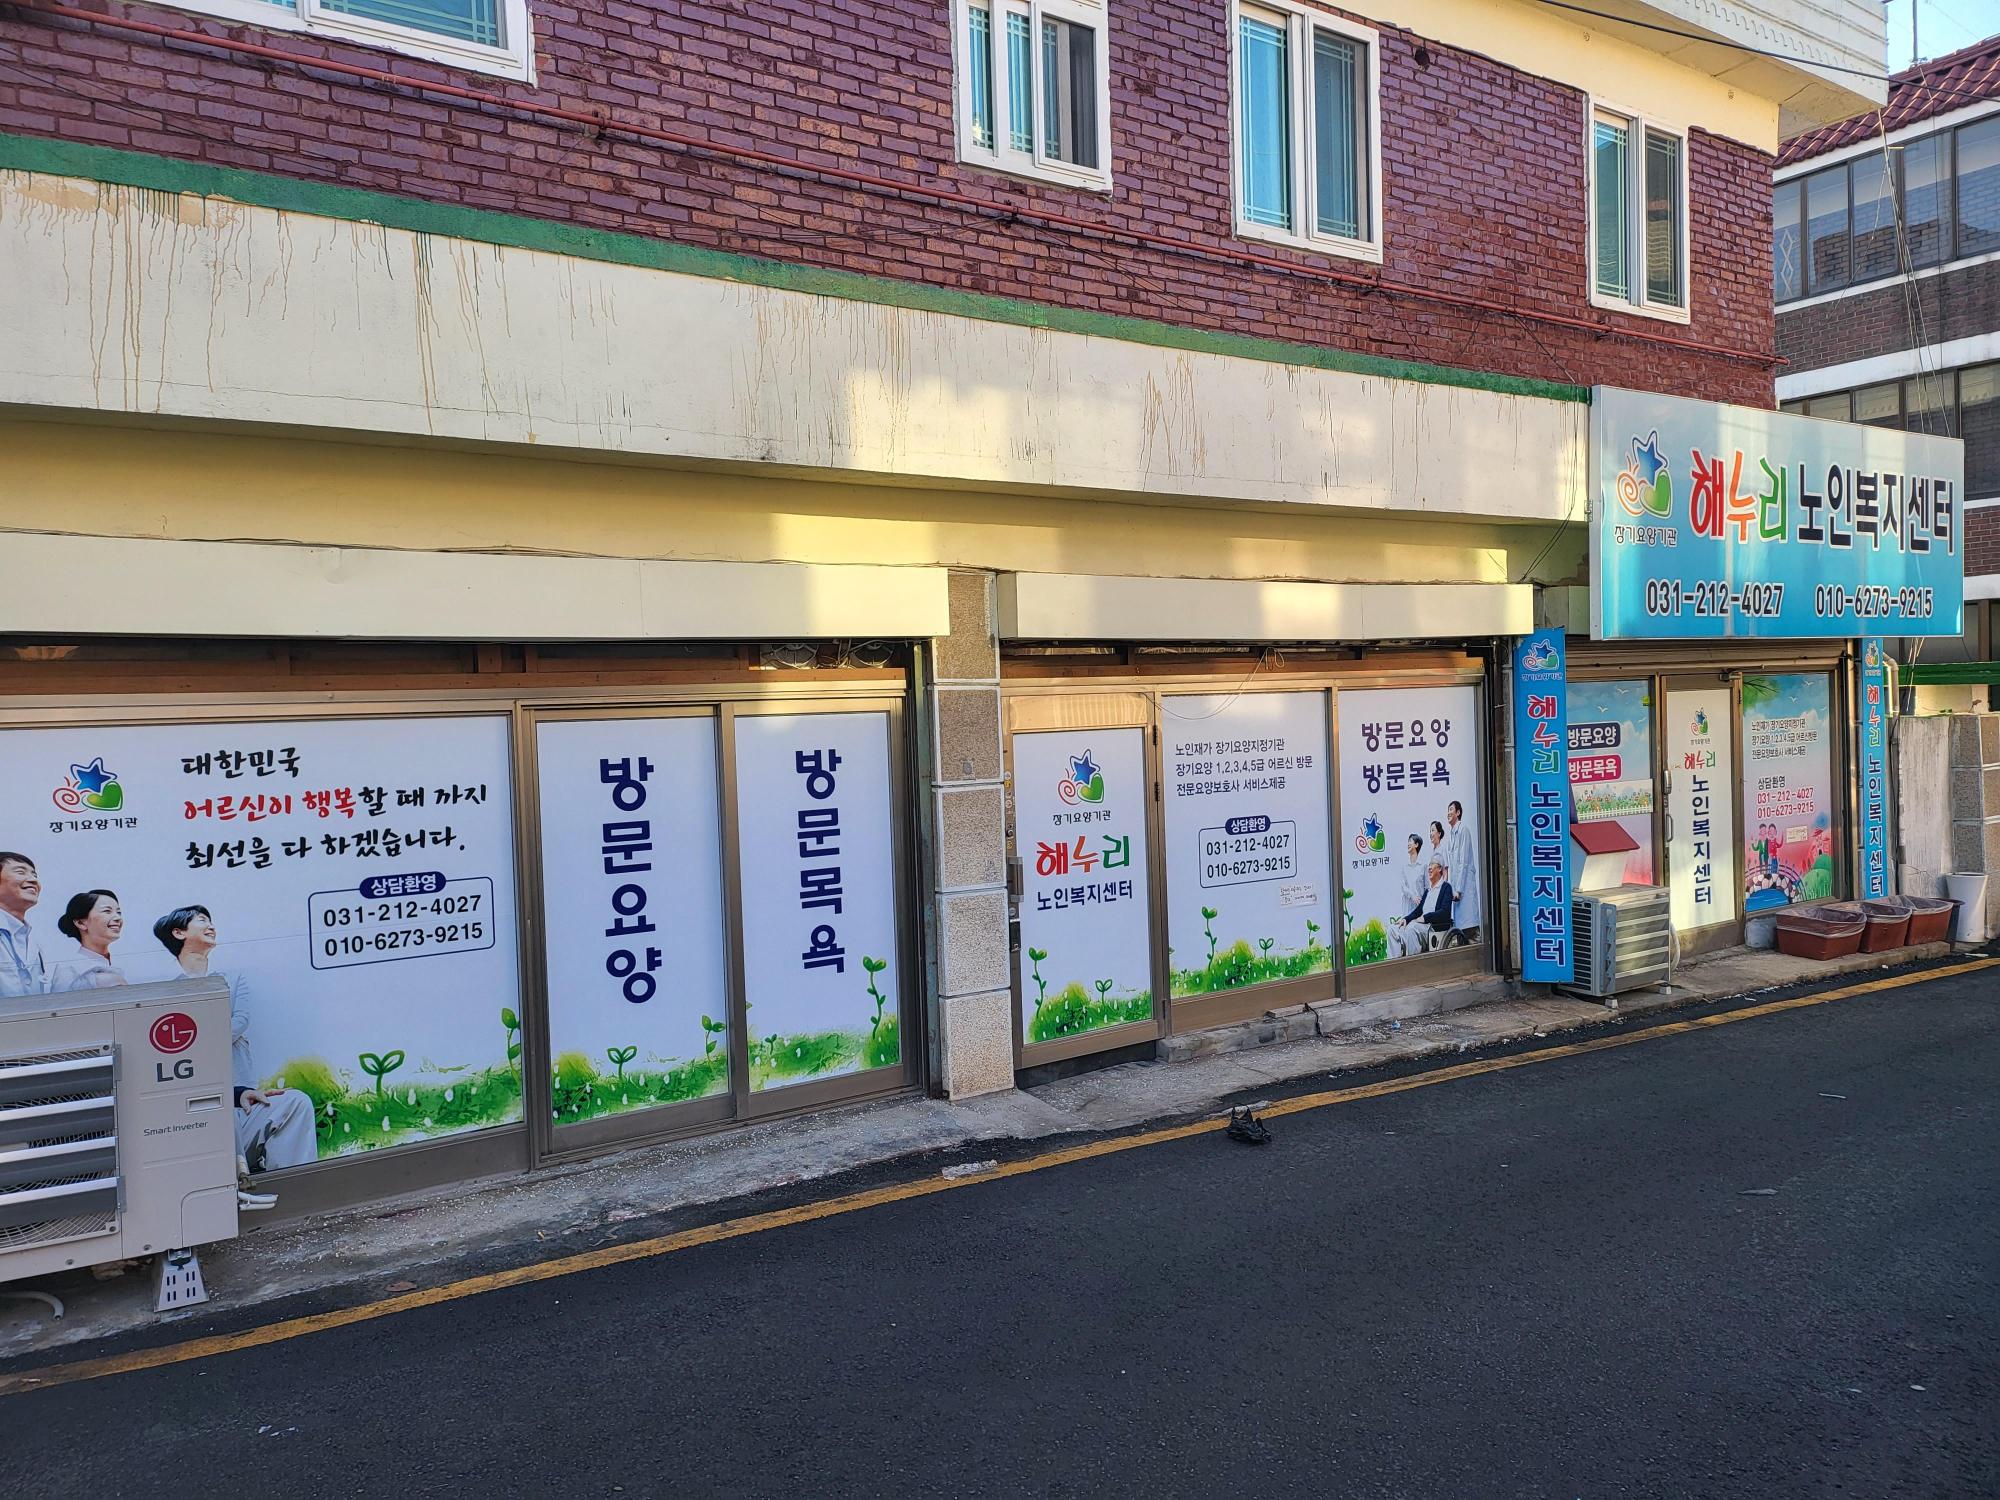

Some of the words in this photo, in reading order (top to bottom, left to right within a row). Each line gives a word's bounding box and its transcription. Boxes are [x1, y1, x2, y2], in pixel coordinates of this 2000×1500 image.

[1690, 450, 1788, 543] 해누리
[1797, 462, 1955, 556] 노인복지센터
[1613, 525, 1678, 548] 장기요양기관
[1646, 579, 1785, 617] 031-212-4027
[1815, 584, 1934, 618] 010-6273-9215
[1867, 685, 1881, 747] 해누리
[1175, 741, 1213, 757] 노인재가
[1215, 737, 1286, 755] 장기요양지정기관
[1361, 718, 1452, 752] 방문요양
[1527, 694, 1560, 774] 해누리
[1568, 726, 1617, 748] 방문요양
[181, 747, 301, 779] 대한민국
[1175, 761, 1214, 777] 장기요양
[1216, 758, 1265, 775] 1,2,3,4,5급
[1267, 756, 1294, 771] 어르신
[1296, 754, 1314, 769] 방문
[1568, 758, 1618, 781] 방문목욕
[1684, 750, 1716, 770] 해누리
[1176, 779, 1240, 797] 전문요양보호사
[1242, 776, 1287, 792] 서비스제공
[1362, 758, 1452, 794] 방문목욕
[1757, 775, 1786, 790] 상담환영
[184, 794, 293, 822] 어르신이
[302, 786, 389, 819] 행복할
[396, 786, 425, 808] 때
[434, 783, 488, 806] 까지
[1757, 801, 1815, 819] 010-6273-9215
[49, 816, 138, 834] 장기요양기관
[1052, 810, 1111, 826] 장기요양기관
[1230, 817, 1267, 833] 상담환영
[1869, 754, 1884, 897] 노인복지센터
[185, 836, 274, 870] 최선을
[281, 836, 313, 859] 다
[320, 825, 467, 859] 하겠습니다.
[1206, 834, 1290, 857] 031-212-4027
[1692, 774, 1713, 905] 노인복지센터
[795, 748, 846, 974] 방문목욕
[1036, 834, 1130, 877] 해누리
[1206, 856, 1291, 879] 010-6273-9215
[1352, 856, 1390, 869] 장기요양기관
[370, 873, 438, 898] 상담환영
[599, 756, 663, 1005] 방문요양
[1530, 782, 1566, 967] 노인복지센터
[1036, 879, 1133, 911] 노인복지센터
[323, 893, 483, 929] 031-212-4027
[324, 921, 484, 958] 010-6273-9215
[156, 1058, 195, 1083] LG
[143, 1124, 173, 1137] Smart
[172, 1120, 209, 1133] Inverter
